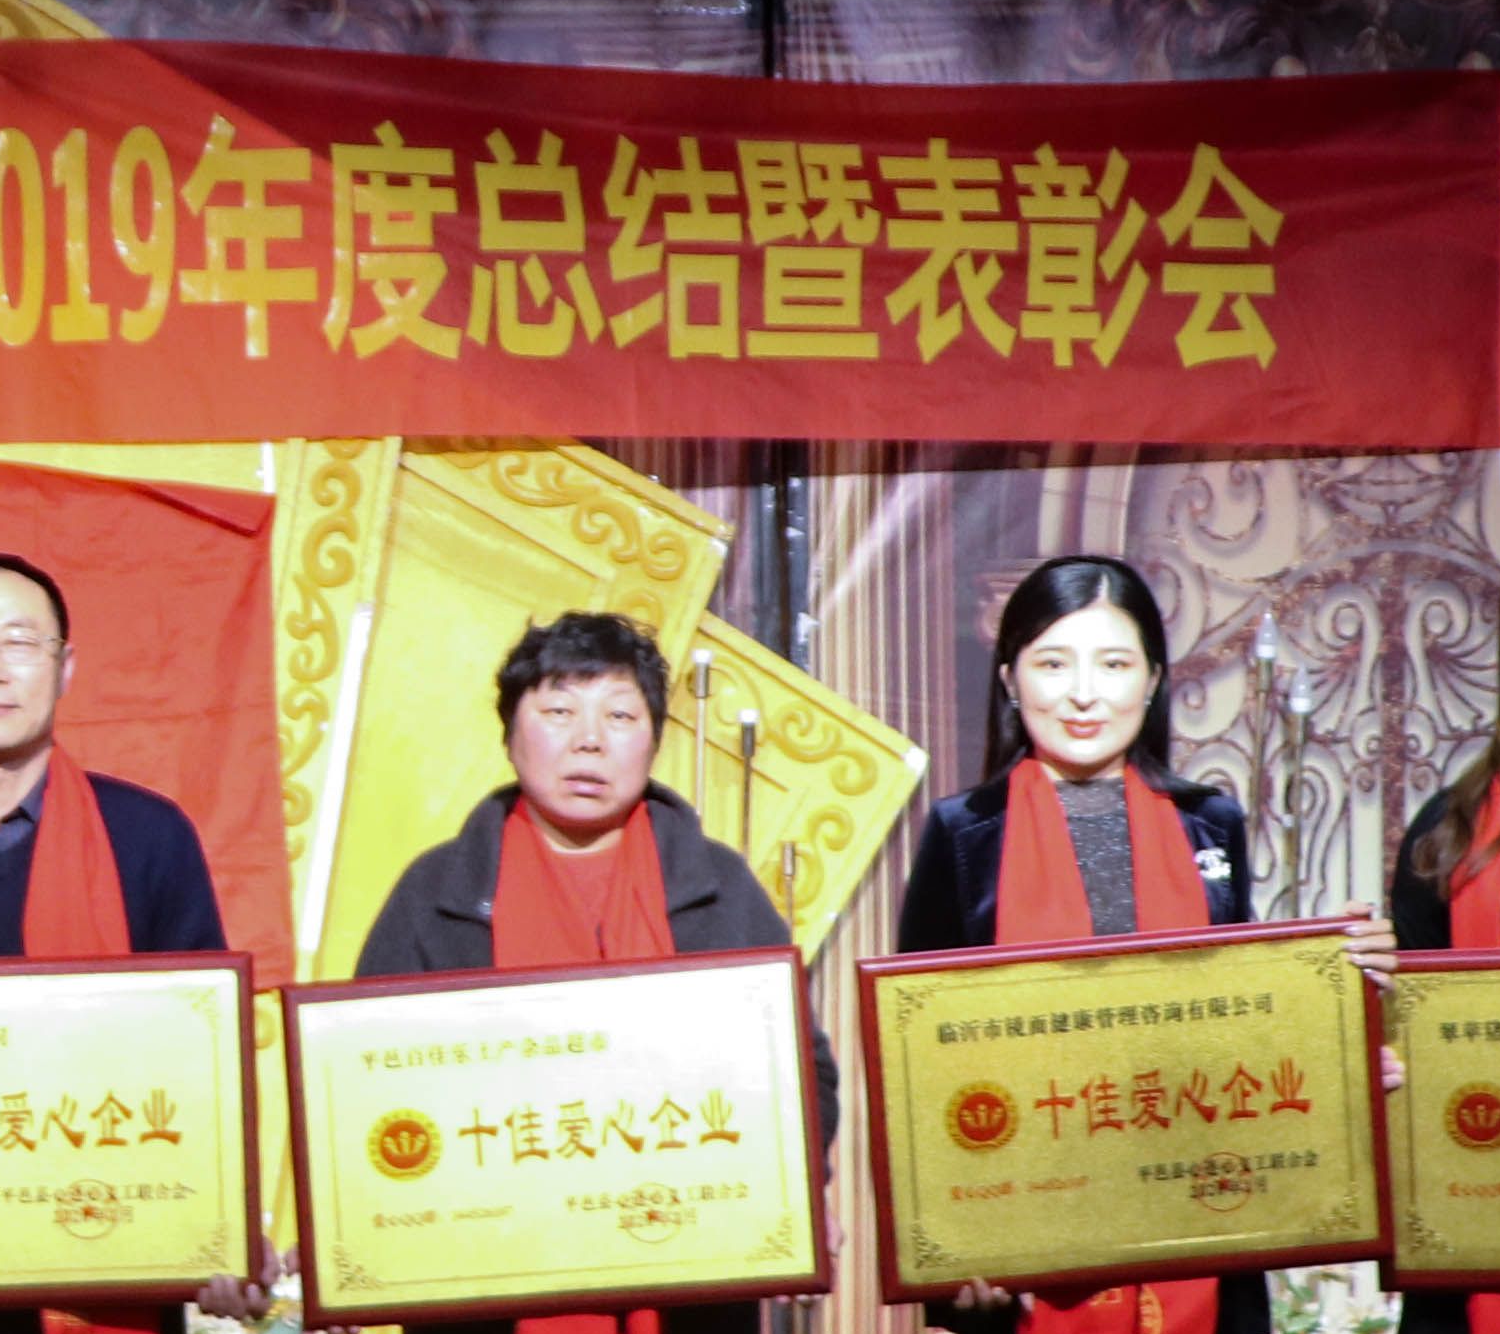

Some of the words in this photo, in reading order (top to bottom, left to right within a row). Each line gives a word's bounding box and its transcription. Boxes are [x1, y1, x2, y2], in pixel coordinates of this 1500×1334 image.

[458, 1087, 742, 1166] 十佳爱心企业
[1034, 1058, 1312, 1141] 十佳爱心企业
